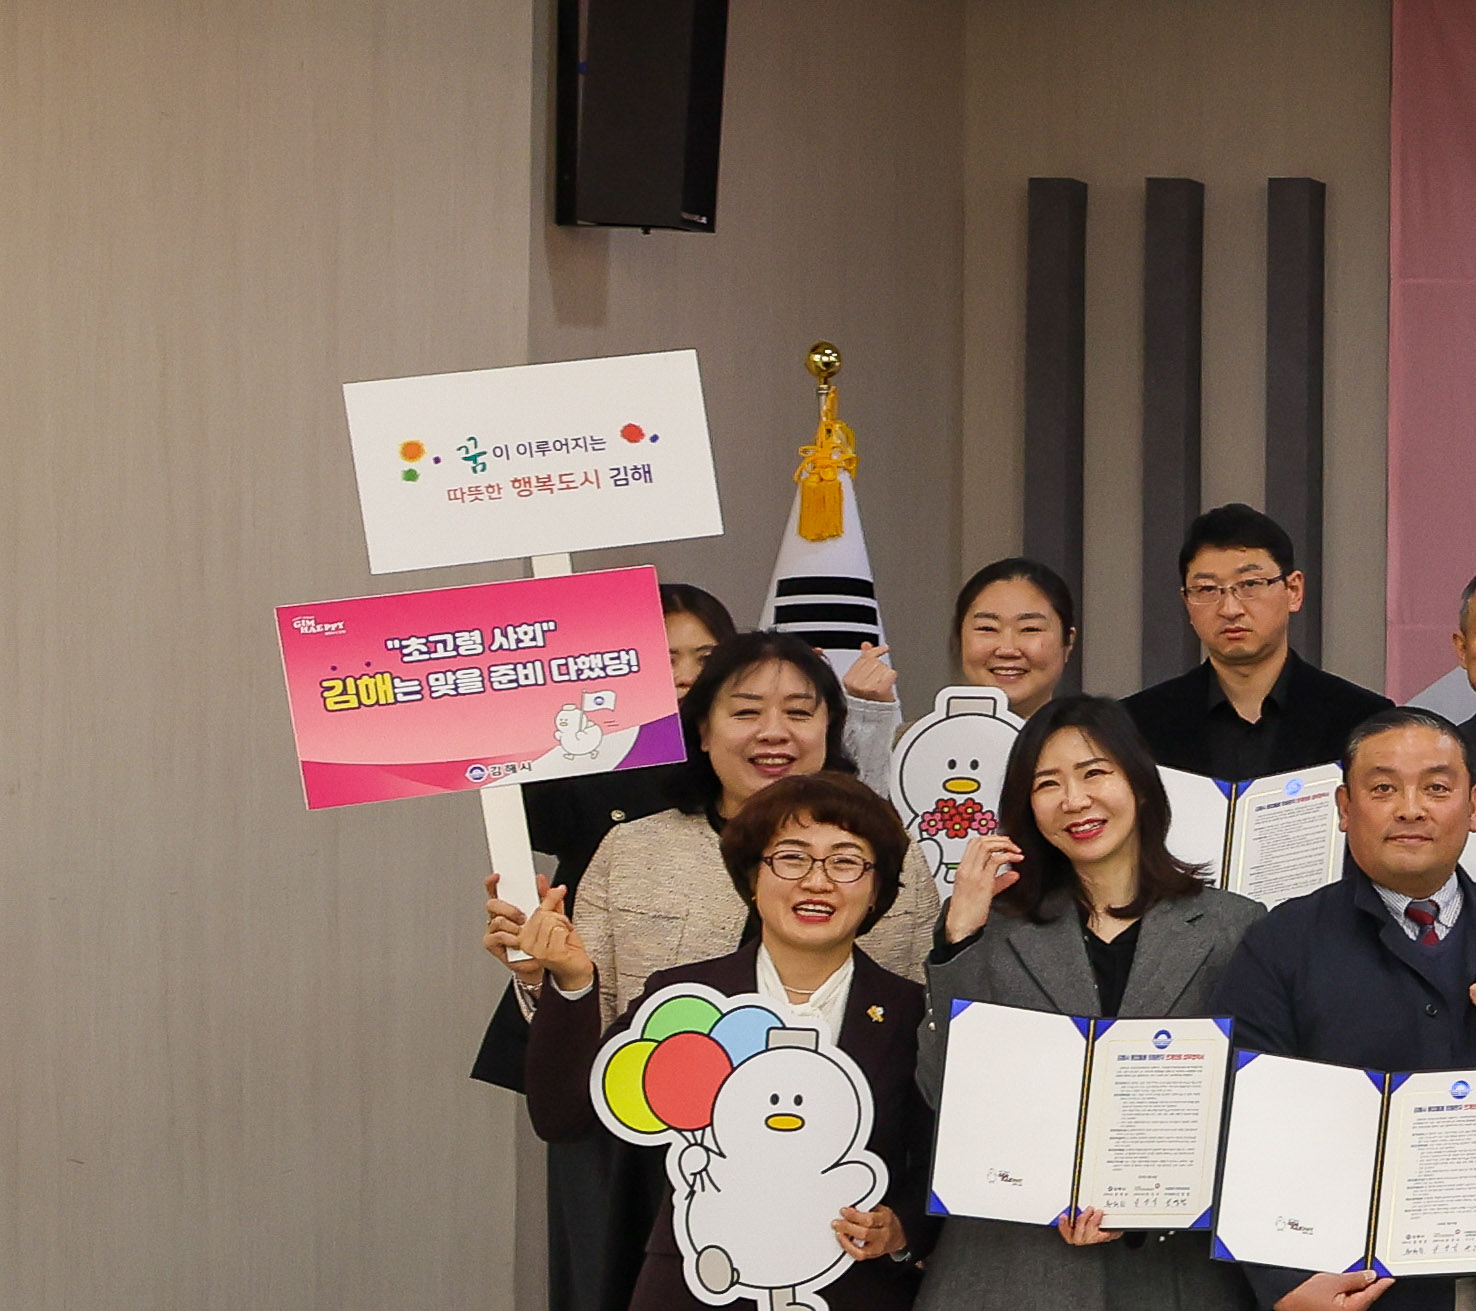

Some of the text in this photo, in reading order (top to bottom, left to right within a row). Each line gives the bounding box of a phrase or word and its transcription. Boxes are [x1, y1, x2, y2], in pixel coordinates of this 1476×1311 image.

[516, 435, 607, 459] 이루어지는
[447, 463, 653, 504] 따뜻한 행복도시 김해
[386, 621, 557, 663] "초고령 사회"
[320, 648, 640, 712] 김해는 맞을 준비 다했당!
[490, 760, 532, 776] 김해시
